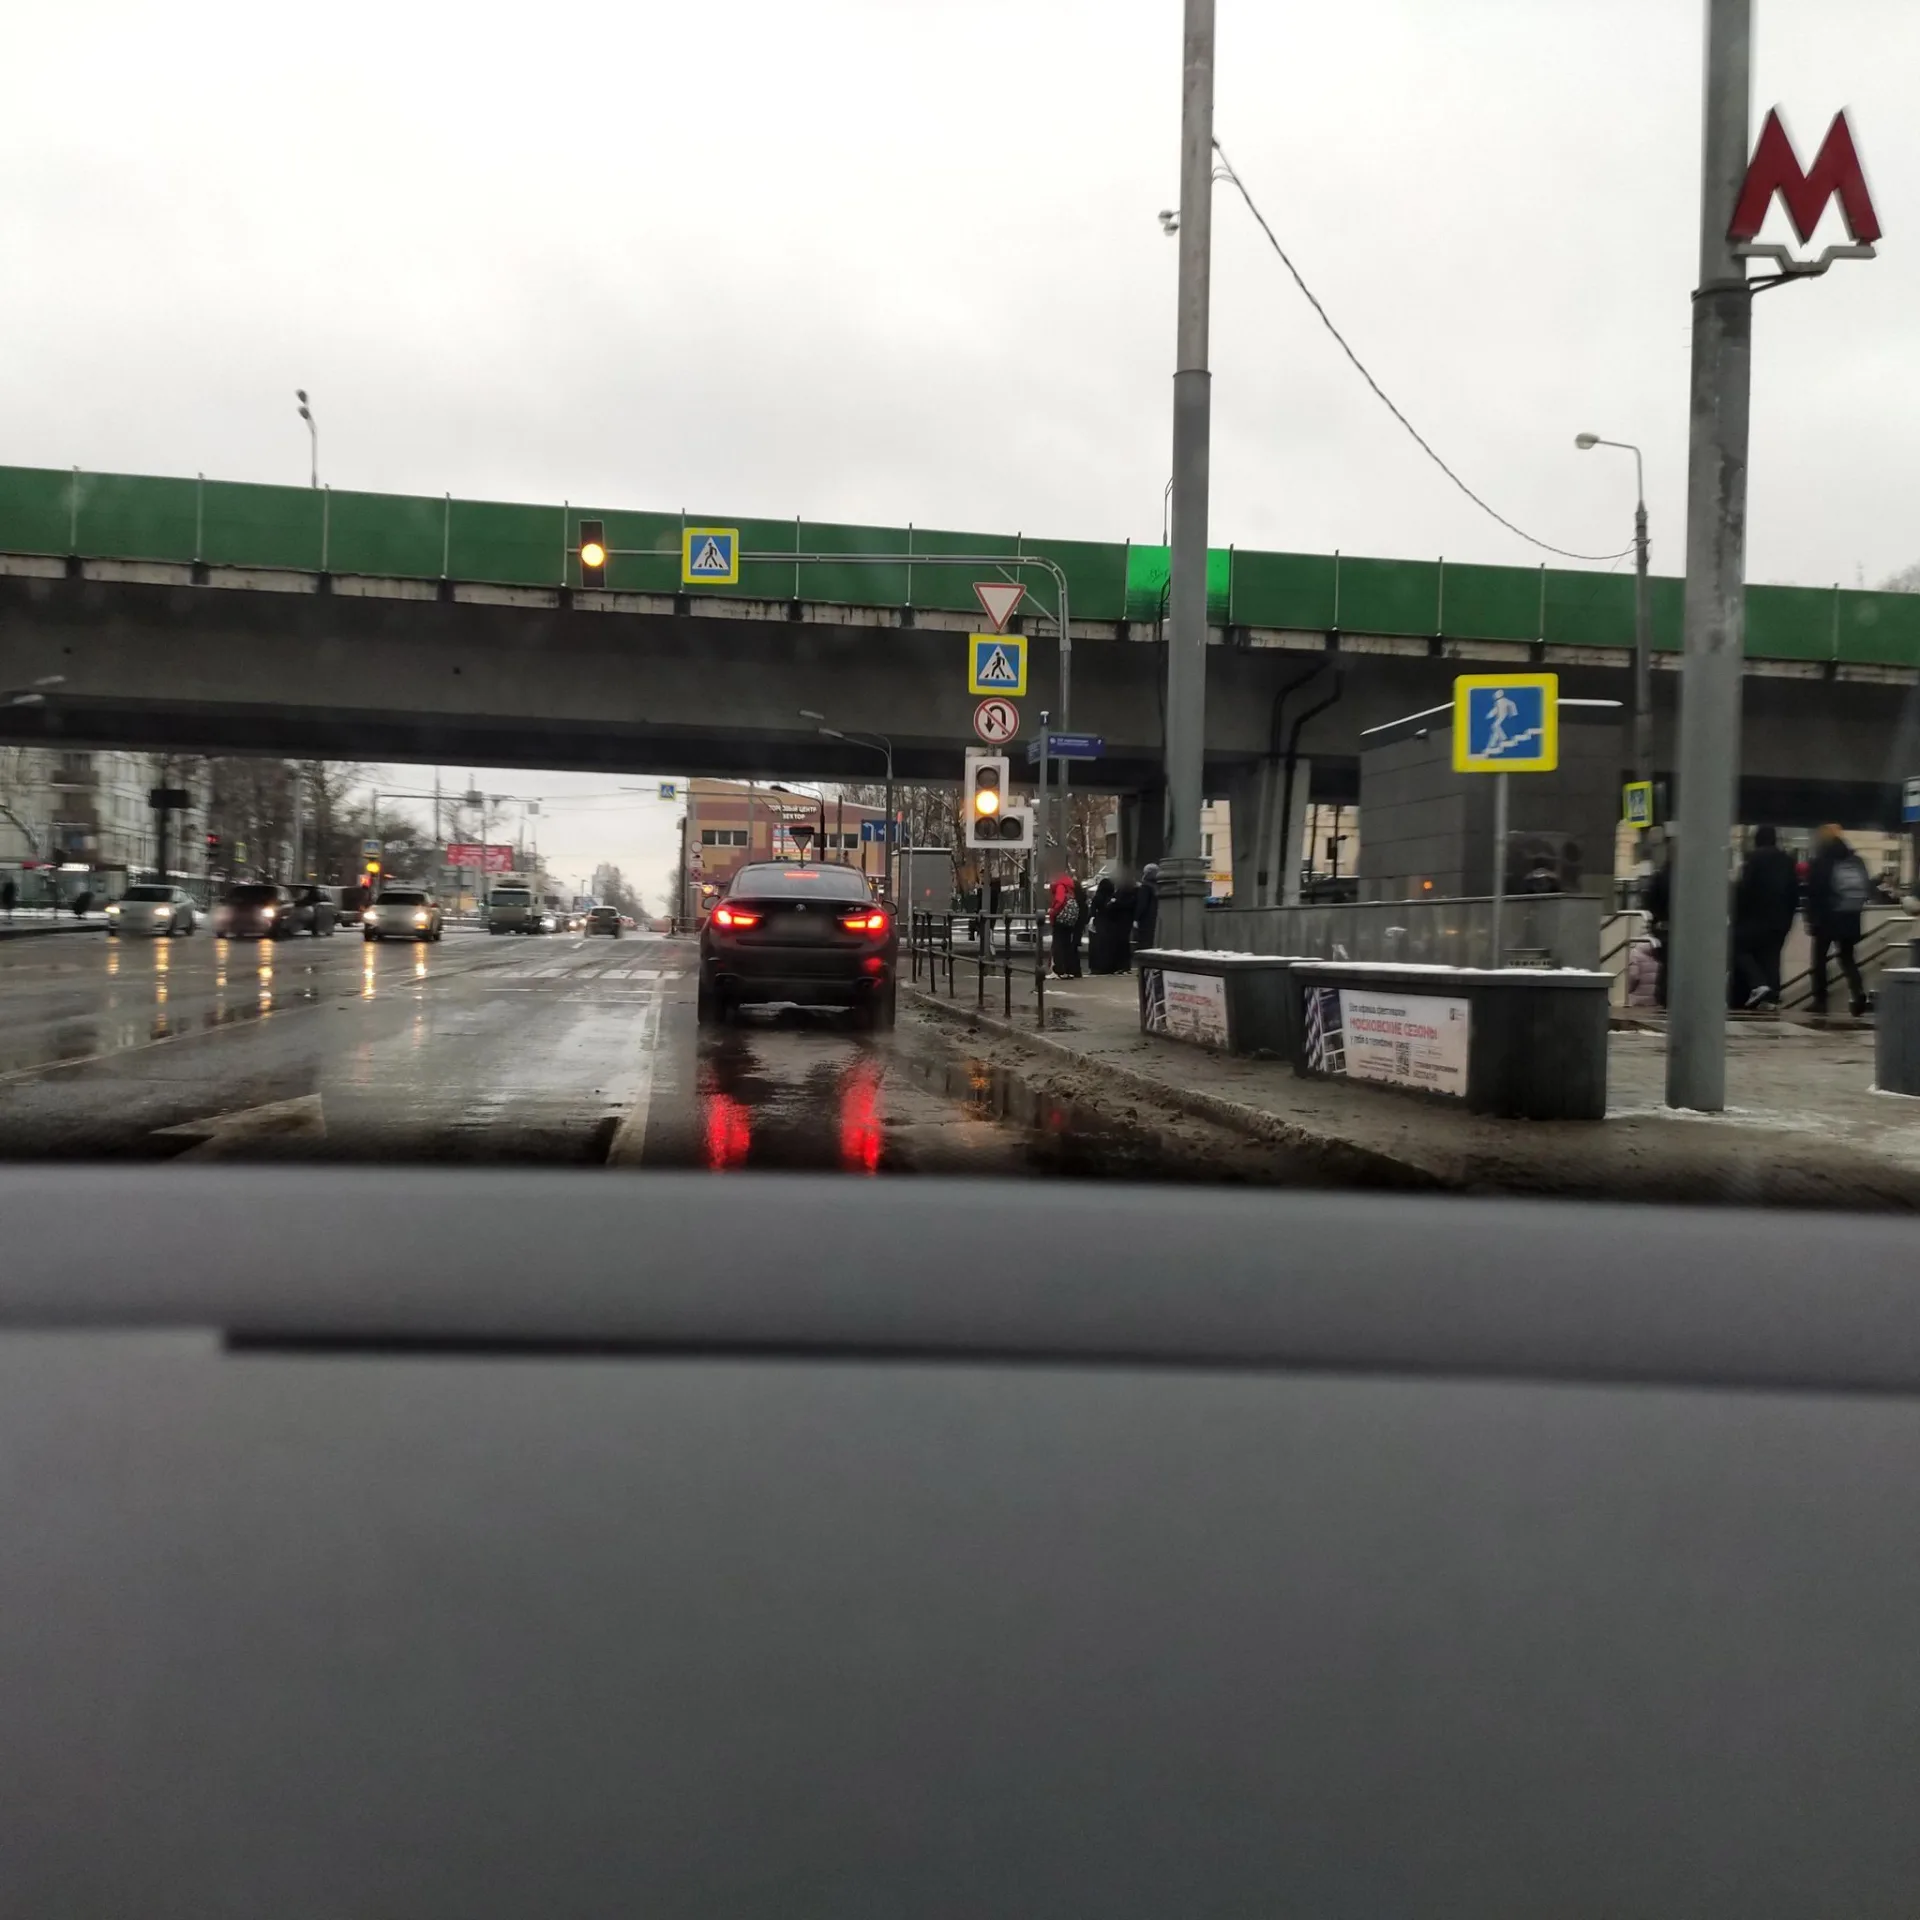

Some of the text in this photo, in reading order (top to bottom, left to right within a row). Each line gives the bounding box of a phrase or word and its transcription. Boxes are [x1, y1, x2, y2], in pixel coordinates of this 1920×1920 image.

[798, 805, 817, 813] ЦЕНТР
[1349, 1017, 1438, 1040] МОСКОВСКИЕ СЕЗОНЫ
